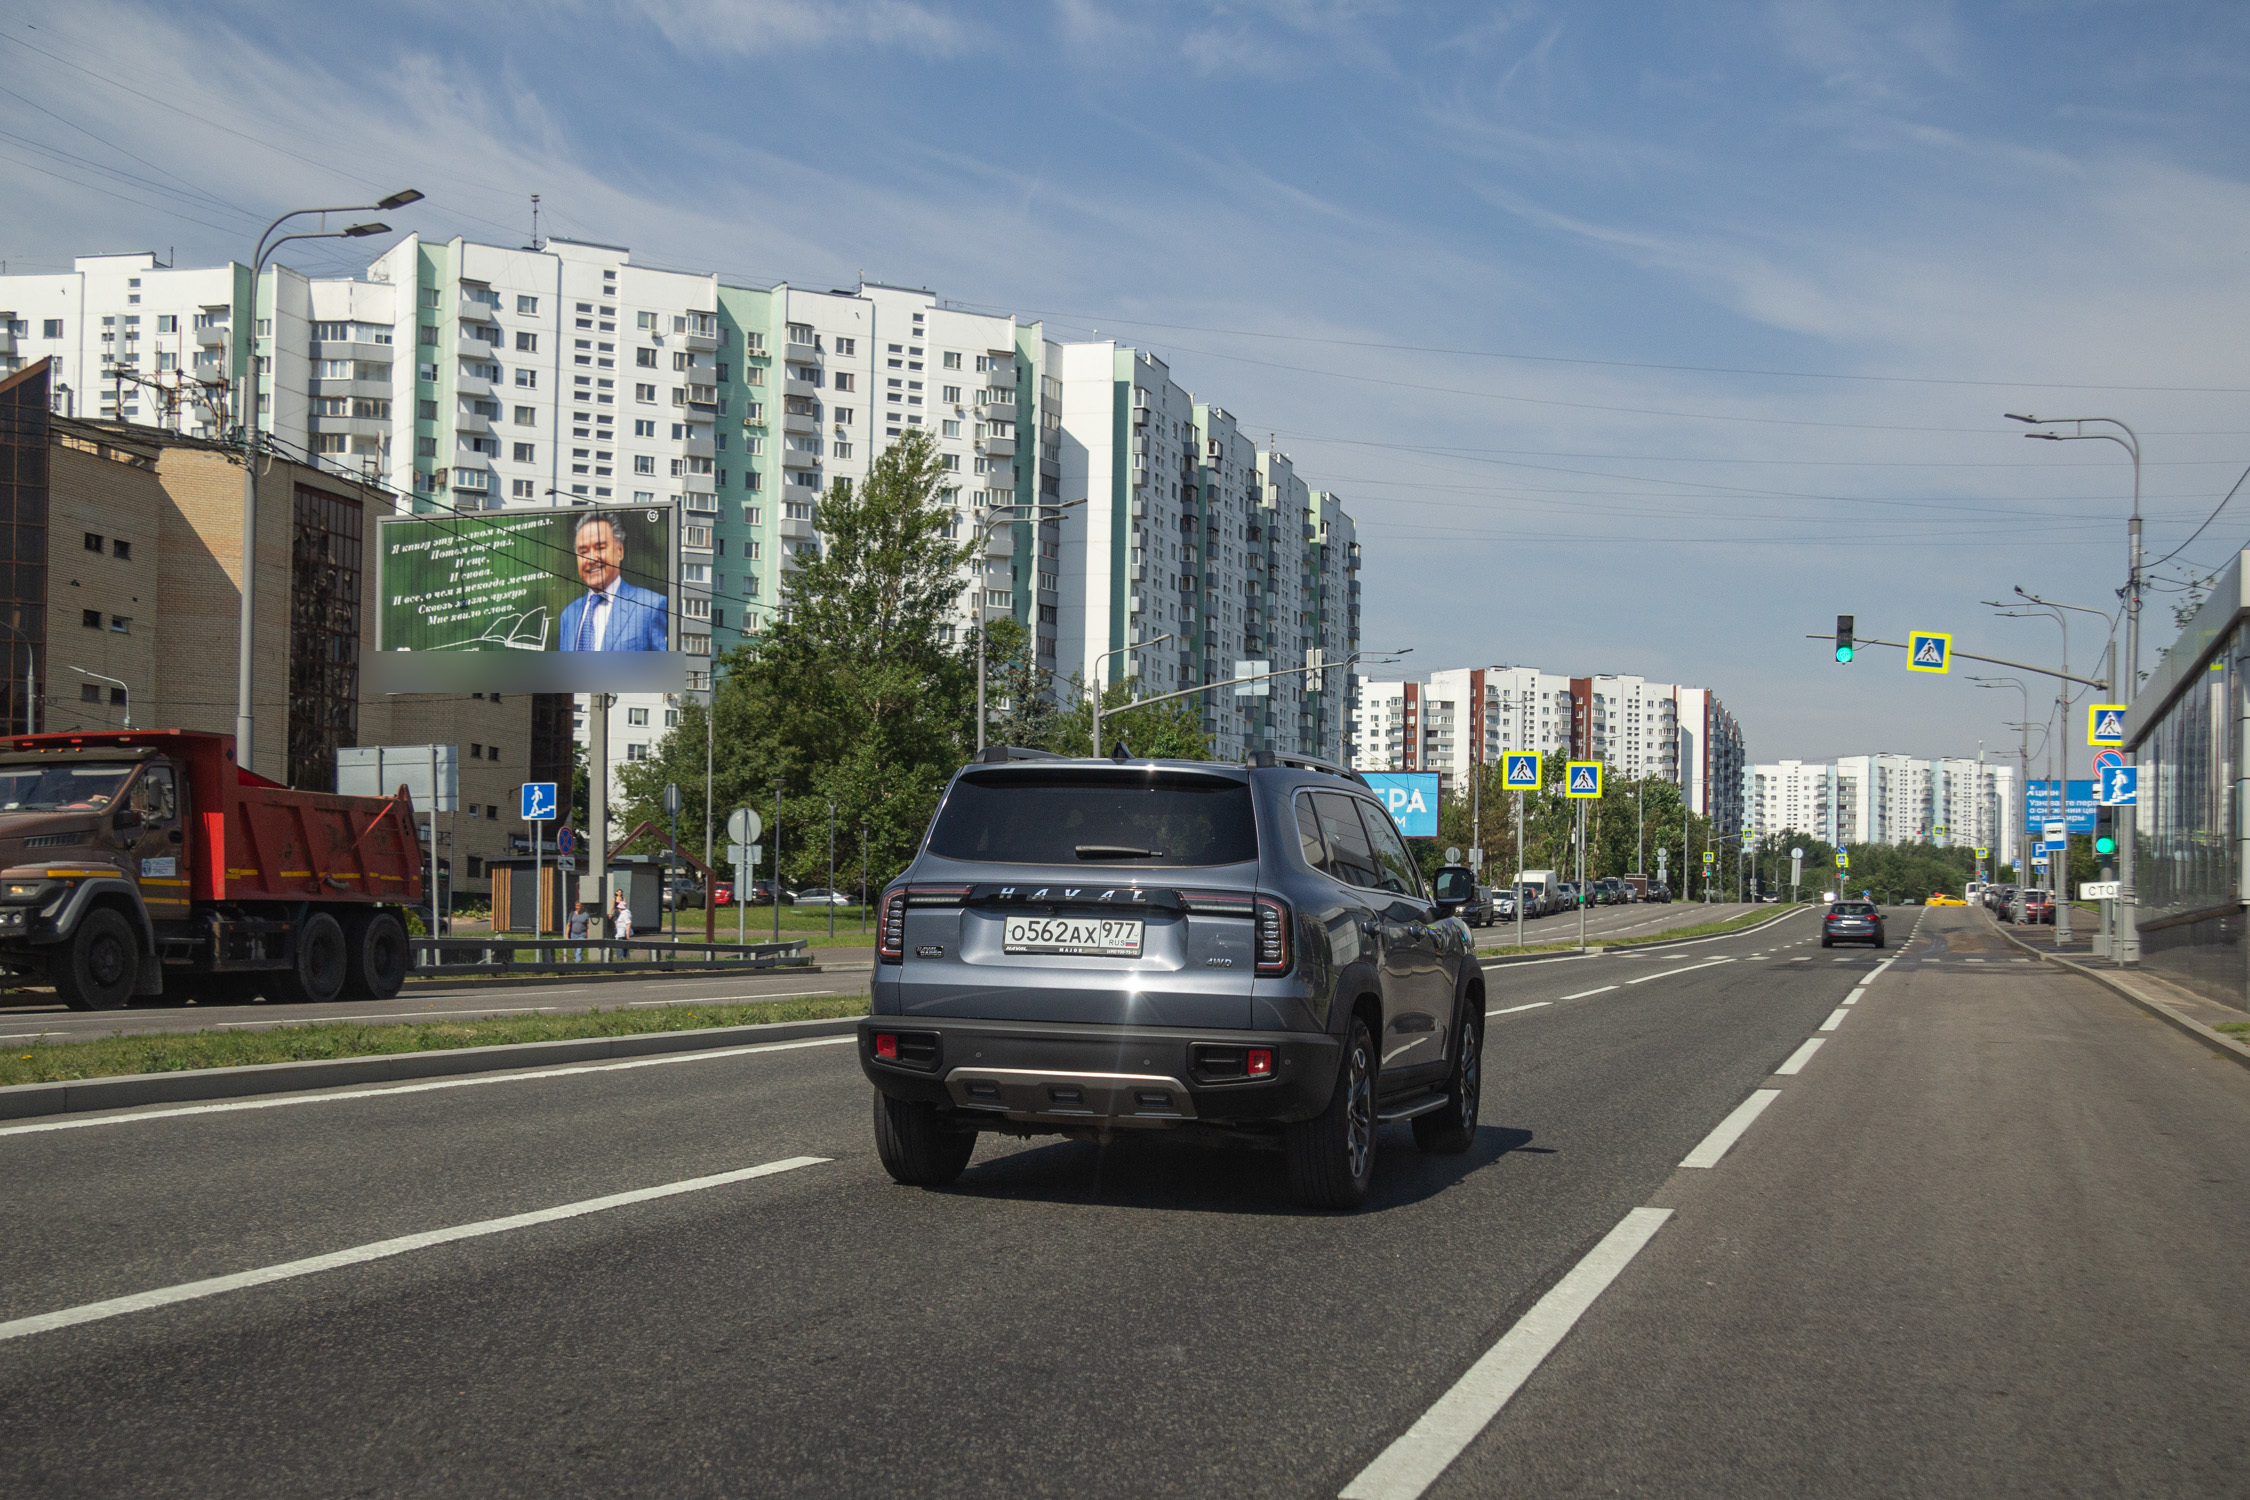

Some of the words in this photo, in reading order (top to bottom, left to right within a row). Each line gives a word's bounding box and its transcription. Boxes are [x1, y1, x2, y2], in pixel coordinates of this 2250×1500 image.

[391, 544, 400, 555] Я
[402, 540, 431, 553] книгу
[433, 536, 454, 547] эту
[455, 529, 494, 542] залпом
[496, 518, 554, 536] прочитал.
[430, 547, 468, 560] Потом
[470, 542, 491, 553] еще
[492, 537, 515, 549] раз,
[455, 558, 464, 568] И
[466, 556, 490, 567] еще,
[449, 572, 458, 583] И
[461, 569, 493, 580] снова.
[393, 595, 401, 606] И
[404, 594, 424, 604] все,
[426, 592, 432, 600] о
[434, 588, 454, 599] чем
[456, 586, 462, 595] я
[464, 578, 505, 592] некогда
[507, 572, 553, 585] мечтал,
[418, 601, 453, 615] Сквозь
[490, 588, 528, 601] чужую
[427, 615, 449, 626] Мне
[450, 610, 482, 622] явило
[483, 603, 516, 616] слово.
[999, 887, 1146, 902] HAVAL
[1102, 921, 1136, 939] 977
[1109, 939, 1125, 947] RUS
[1206, 957, 1232, 967] 4WD
